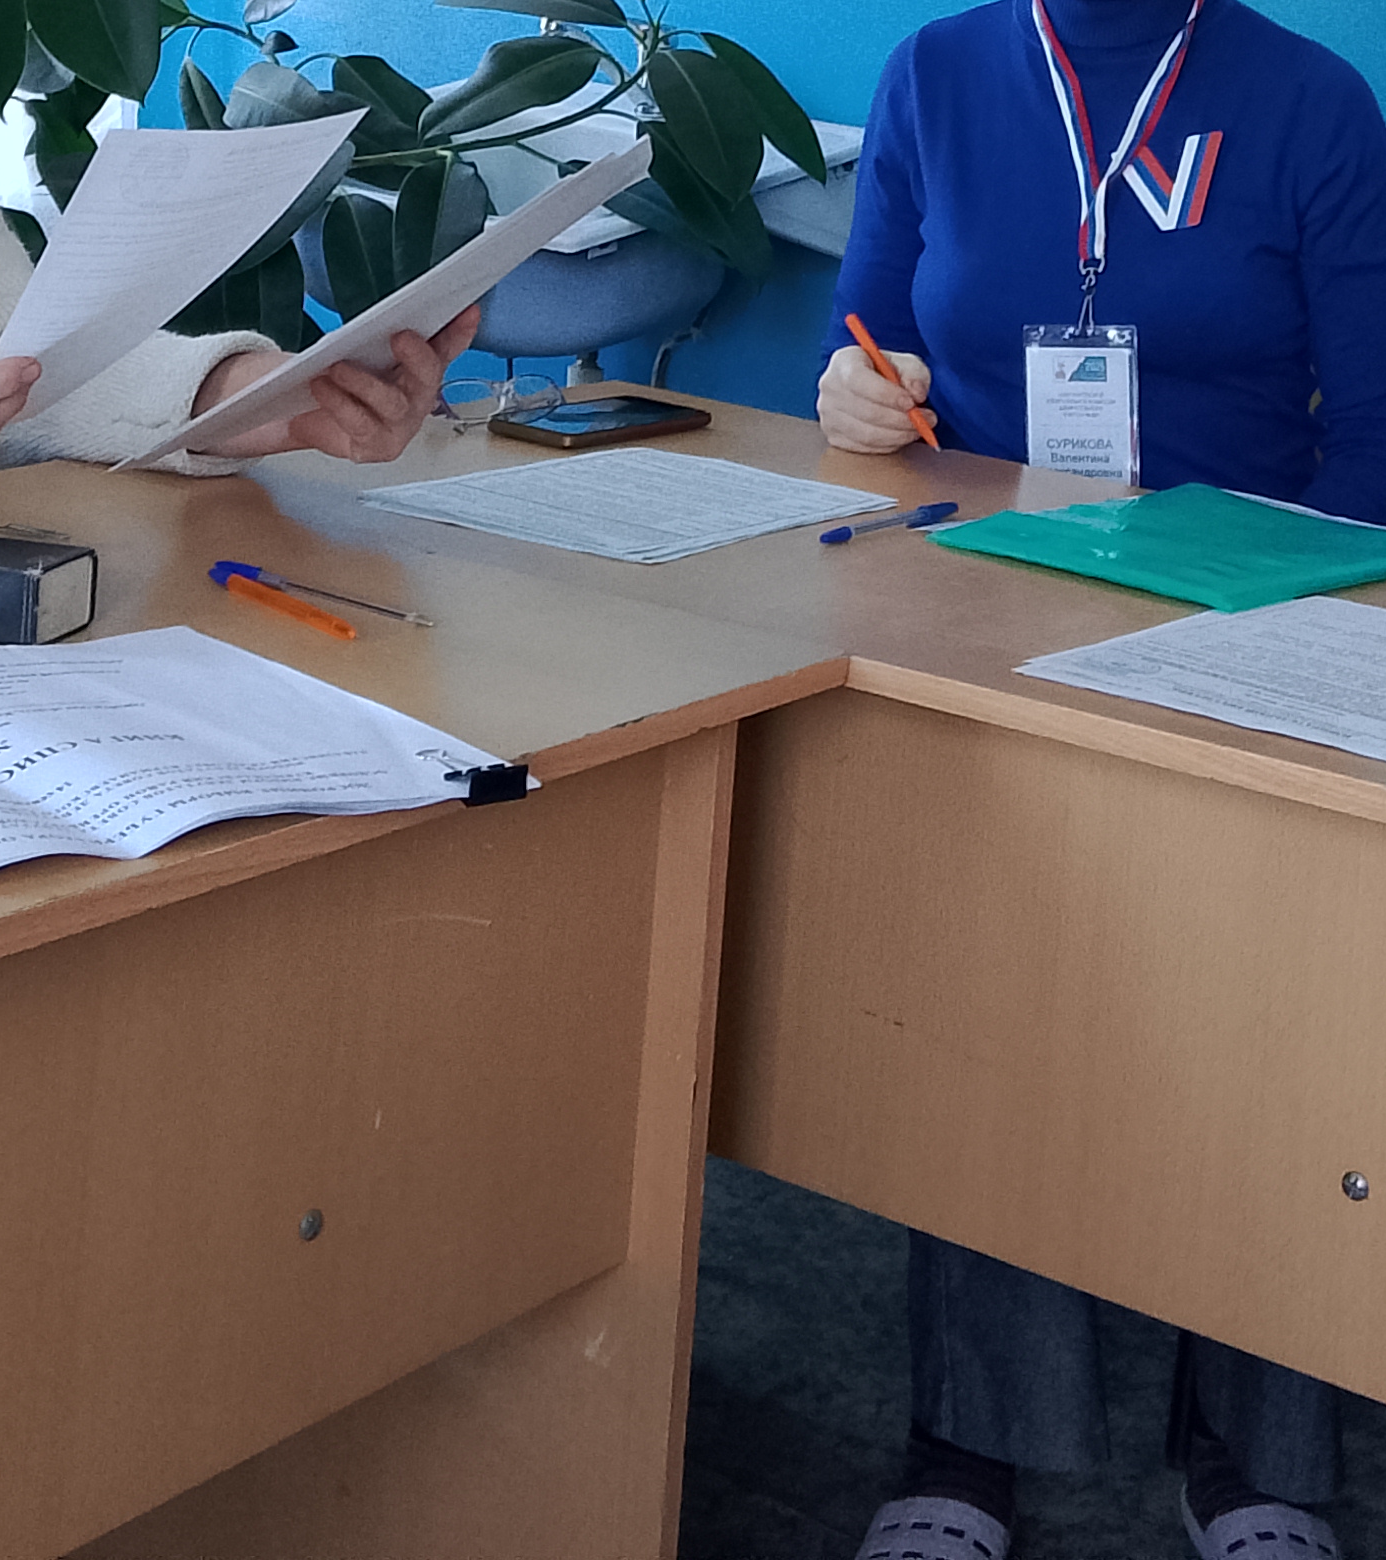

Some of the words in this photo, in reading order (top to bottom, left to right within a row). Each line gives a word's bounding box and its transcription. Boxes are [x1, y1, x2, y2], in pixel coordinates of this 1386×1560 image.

[1046, 439, 1114, 449] СУРИКОВА
[1050, 452, 1110, 463] Валентина
[83, 733, 185, 744] КНИГА
